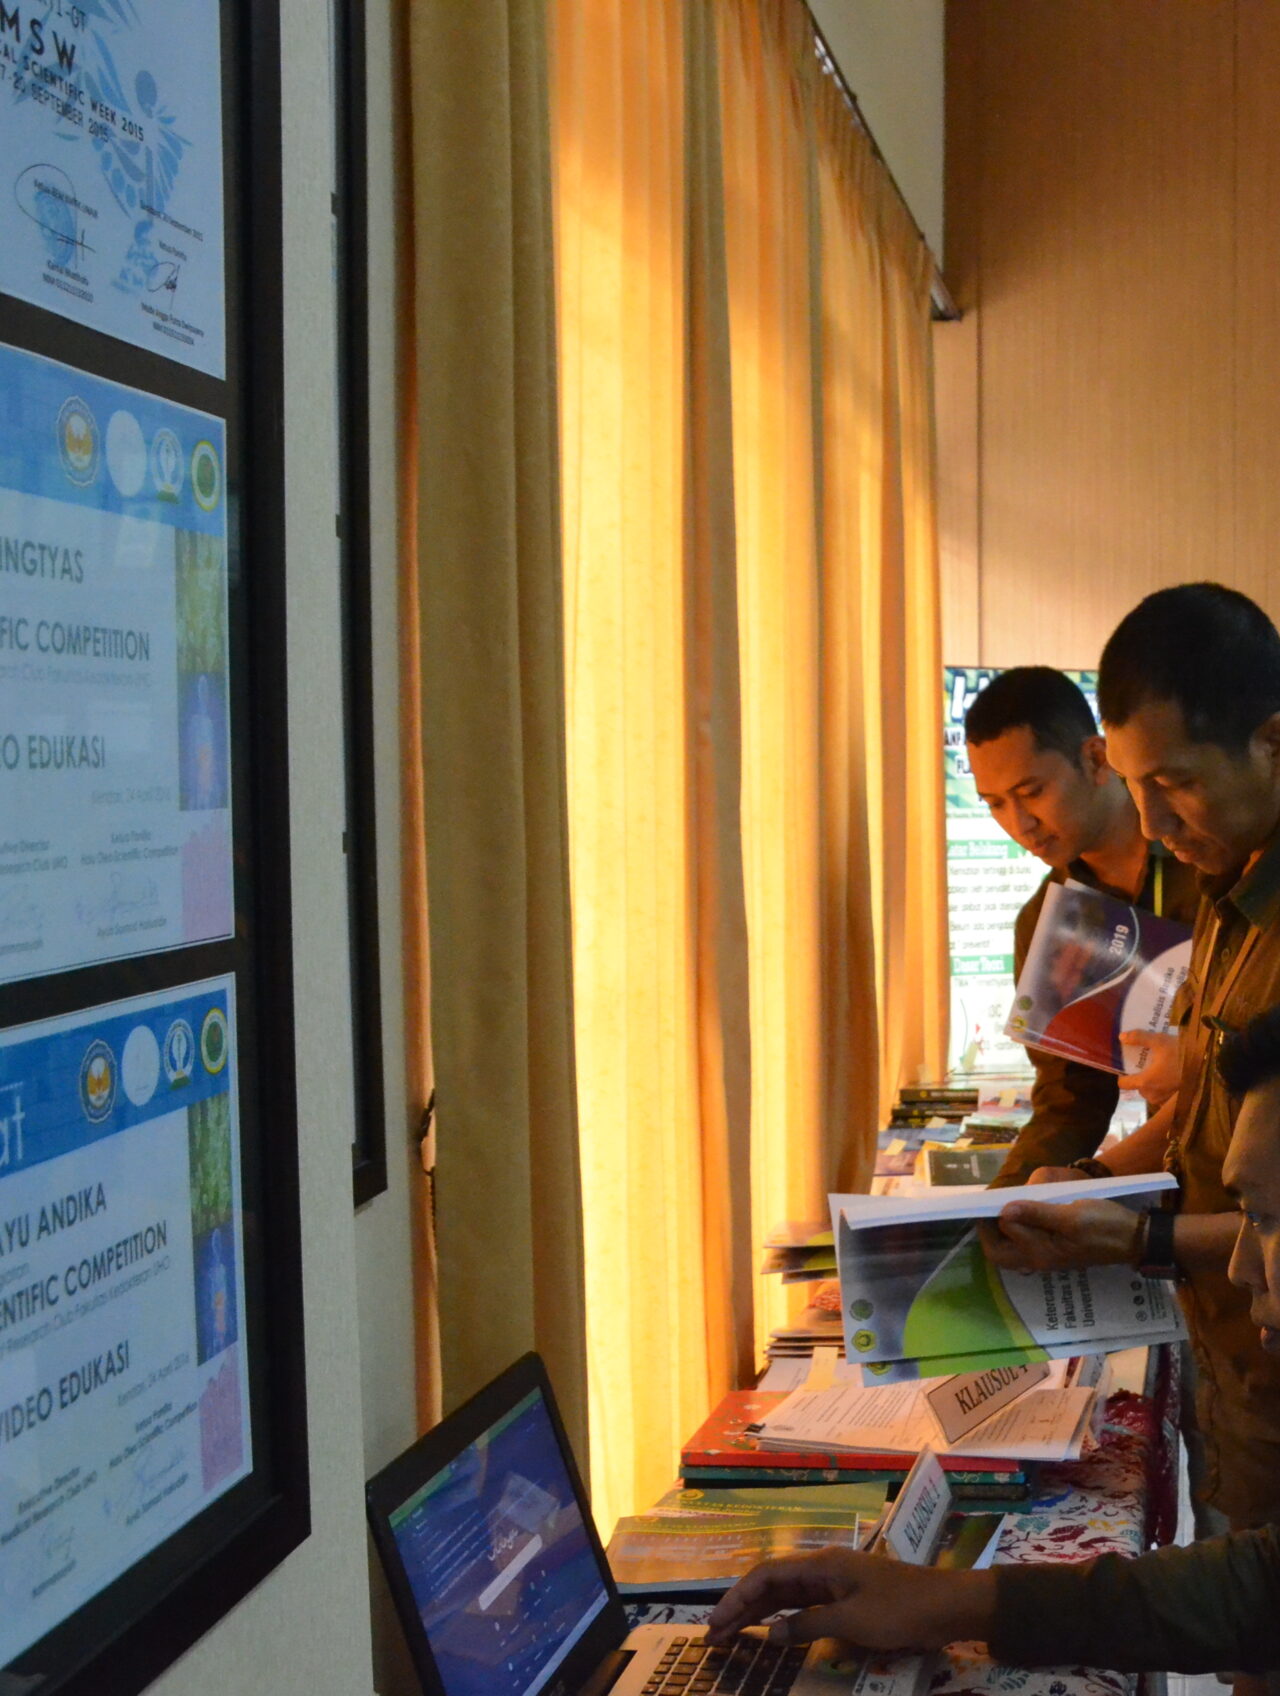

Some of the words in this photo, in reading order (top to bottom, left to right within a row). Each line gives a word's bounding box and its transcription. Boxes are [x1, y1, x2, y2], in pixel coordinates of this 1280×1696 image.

[0, 43, 17, 63] AL
[22, 55, 85, 105] SCIENTIFIC
[90, 97, 117, 126] WEEK
[121, 116, 144, 142] 2015
[0, 615, 30, 651] FIC
[36, 620, 150, 661] COMPETITION
[0, 734, 21, 770] O
[28, 735, 105, 770] EDUKASI
[1109, 924, 1130, 955] 2019
[37, 1180, 107, 1241] ANDIKA
[0, 1274, 60, 1330] NTIFIC
[64, 1219, 167, 1297] COMPETITION
[1062, 1283, 1077, 1329] Fakultas
[59, 1339, 129, 1410] EDUKASI
[955, 1366, 1019, 1415] KLAUSUL
[904, 1486, 937, 1554] KLAUSUL
